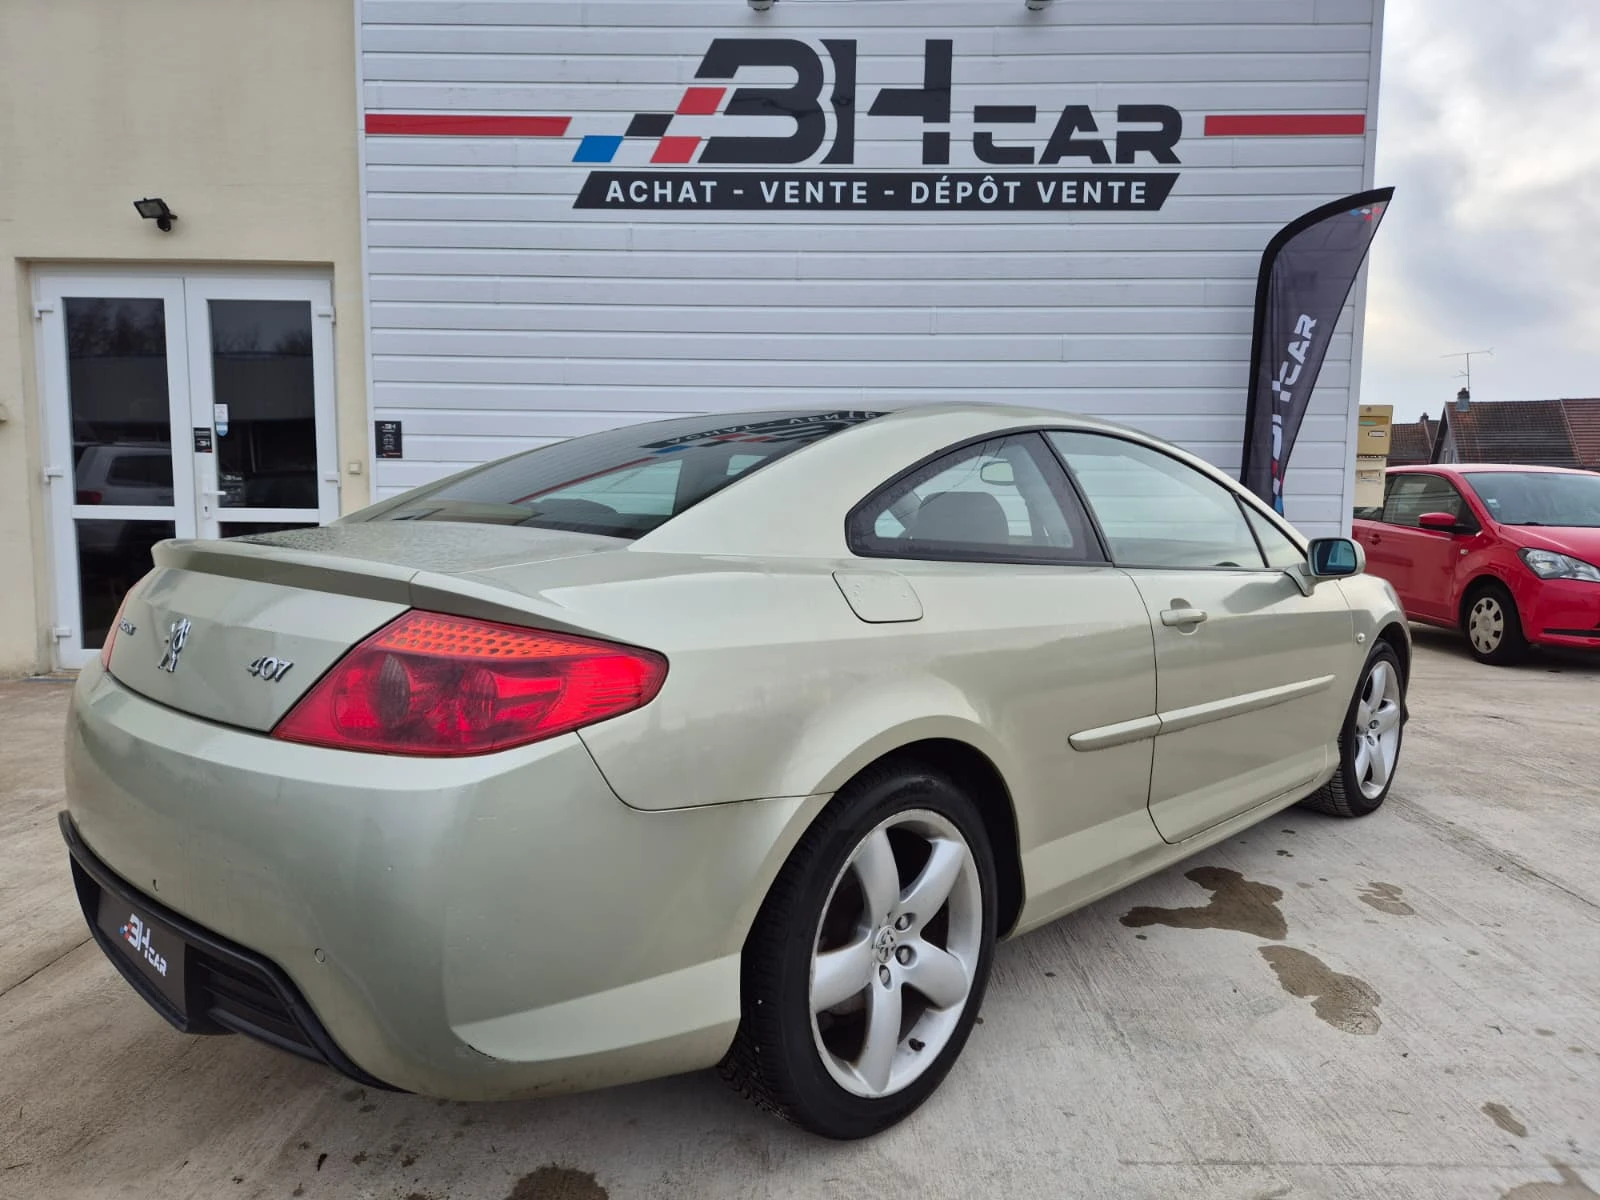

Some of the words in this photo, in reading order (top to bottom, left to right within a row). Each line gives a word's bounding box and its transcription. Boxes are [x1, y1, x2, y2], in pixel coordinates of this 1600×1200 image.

[973, 104, 1183, 164] CAR
[604, 179, 717, 204] ACHAT
[760, 180, 868, 204] VENTE
[910, 174, 1022, 204] DÉPÔT
[1036, 181, 1147, 204] VENTE
[247, 656, 294, 682] 407
